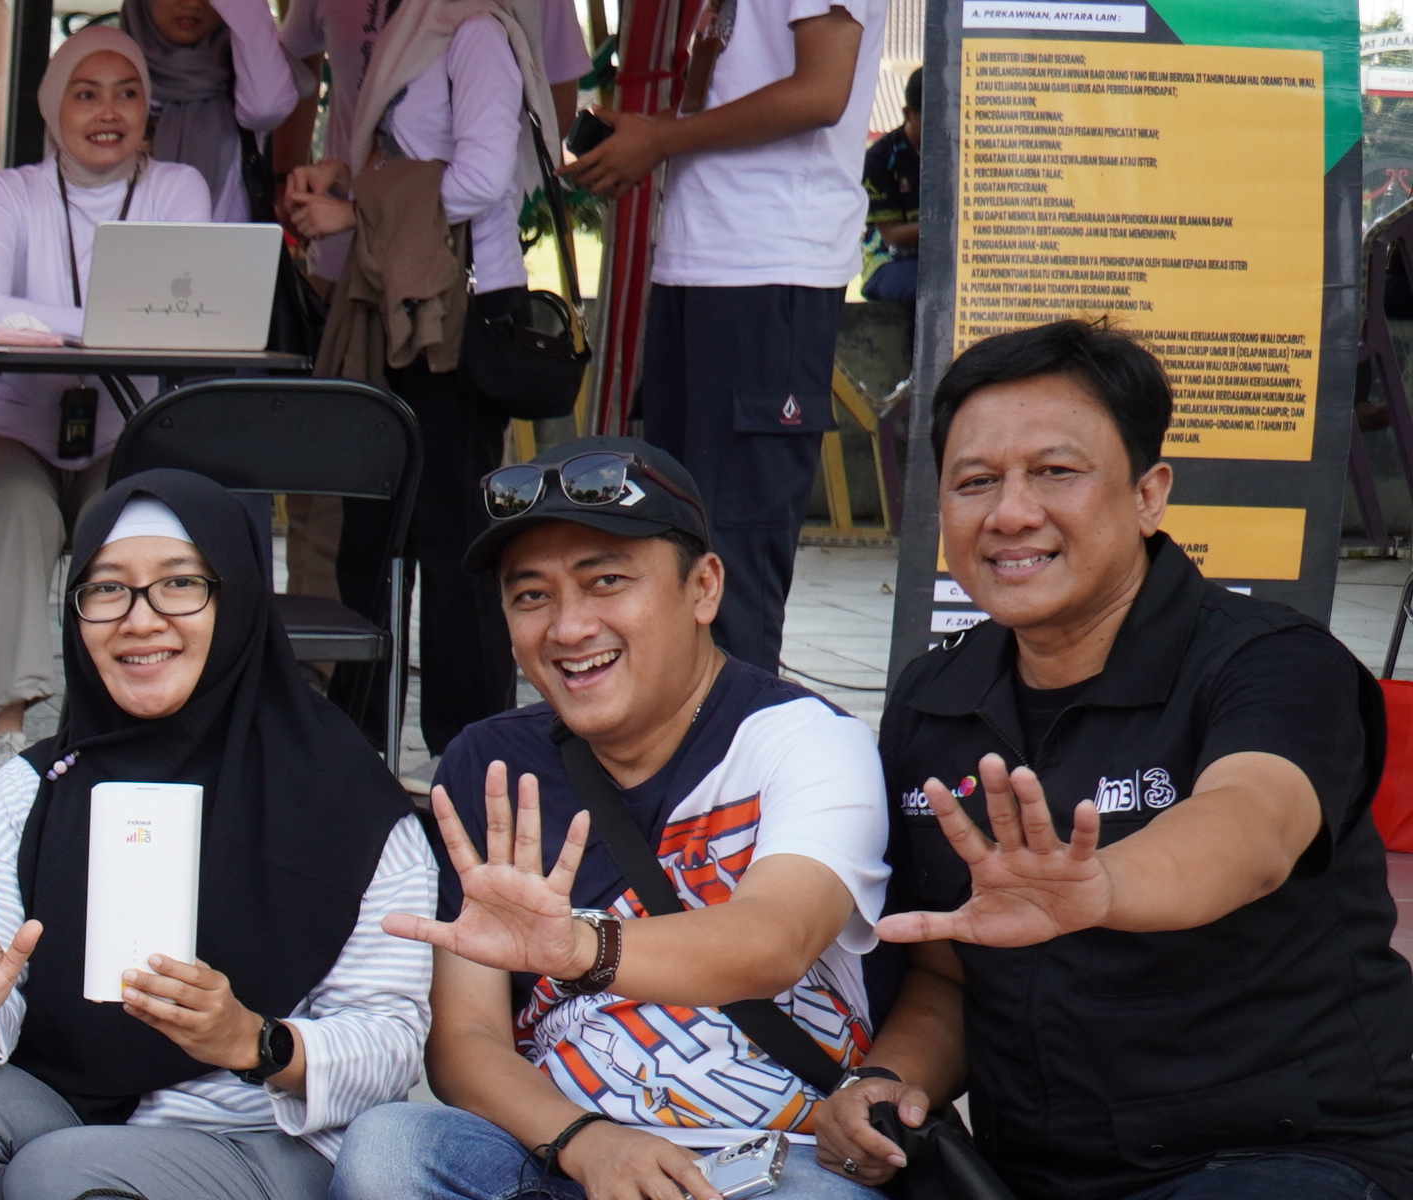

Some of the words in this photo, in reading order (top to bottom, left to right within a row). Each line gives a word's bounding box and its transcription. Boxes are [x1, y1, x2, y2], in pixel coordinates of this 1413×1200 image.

[972, 10, 981, 18] A.
[984, 11, 1051, 21] PERKAWINAN,
[1053, 12, 1093, 21] ANTARA
[1095, 13, 1117, 22] LAIN
[1154, 331, 1177, 341] DALAM
[1177, 332, 1189, 341] HAL
[1190, 332, 1228, 342] KEKUASAAN
[1229, 333, 1258, 343] SEORANG
[1166, 345, 1186, 355] BELUM
[1187, 346, 1208, 356] CUKUP
[1210, 347, 1228, 356] UMUR
[1291, 349, 1312, 359] TAHUN
[1260, 421, 1282, 431] TAHUN
[1283, 421, 1296, 432] 1974
[1166, 433, 1184, 443] YANG
